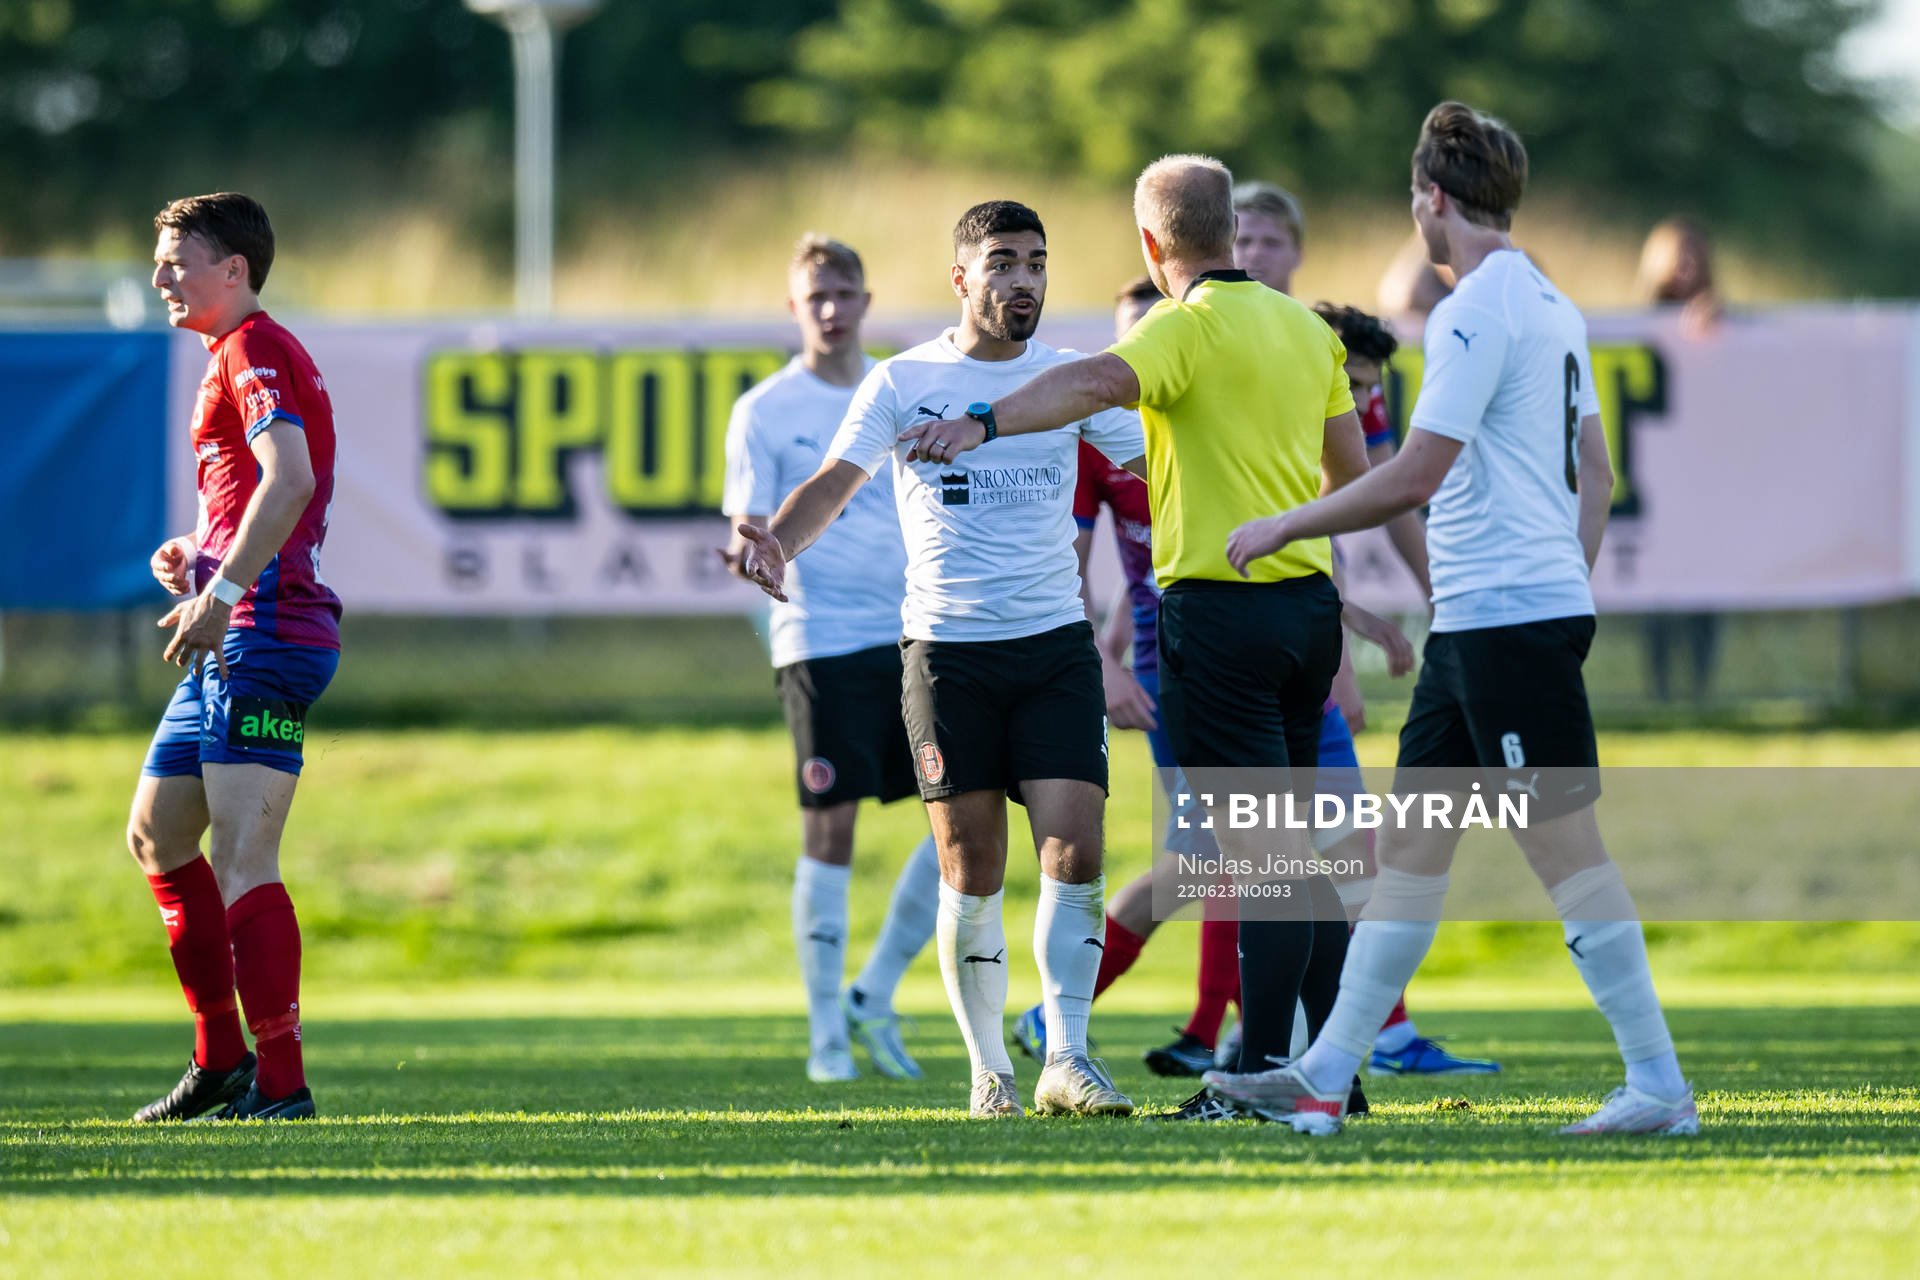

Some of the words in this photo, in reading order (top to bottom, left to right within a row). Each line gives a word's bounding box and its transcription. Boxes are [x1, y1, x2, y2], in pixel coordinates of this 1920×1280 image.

[424, 346, 800, 520] SPOR
[972, 466, 1061, 489] KRONOSUND
[204, 702, 215, 730] 3
[1501, 732, 1526, 769] 6
